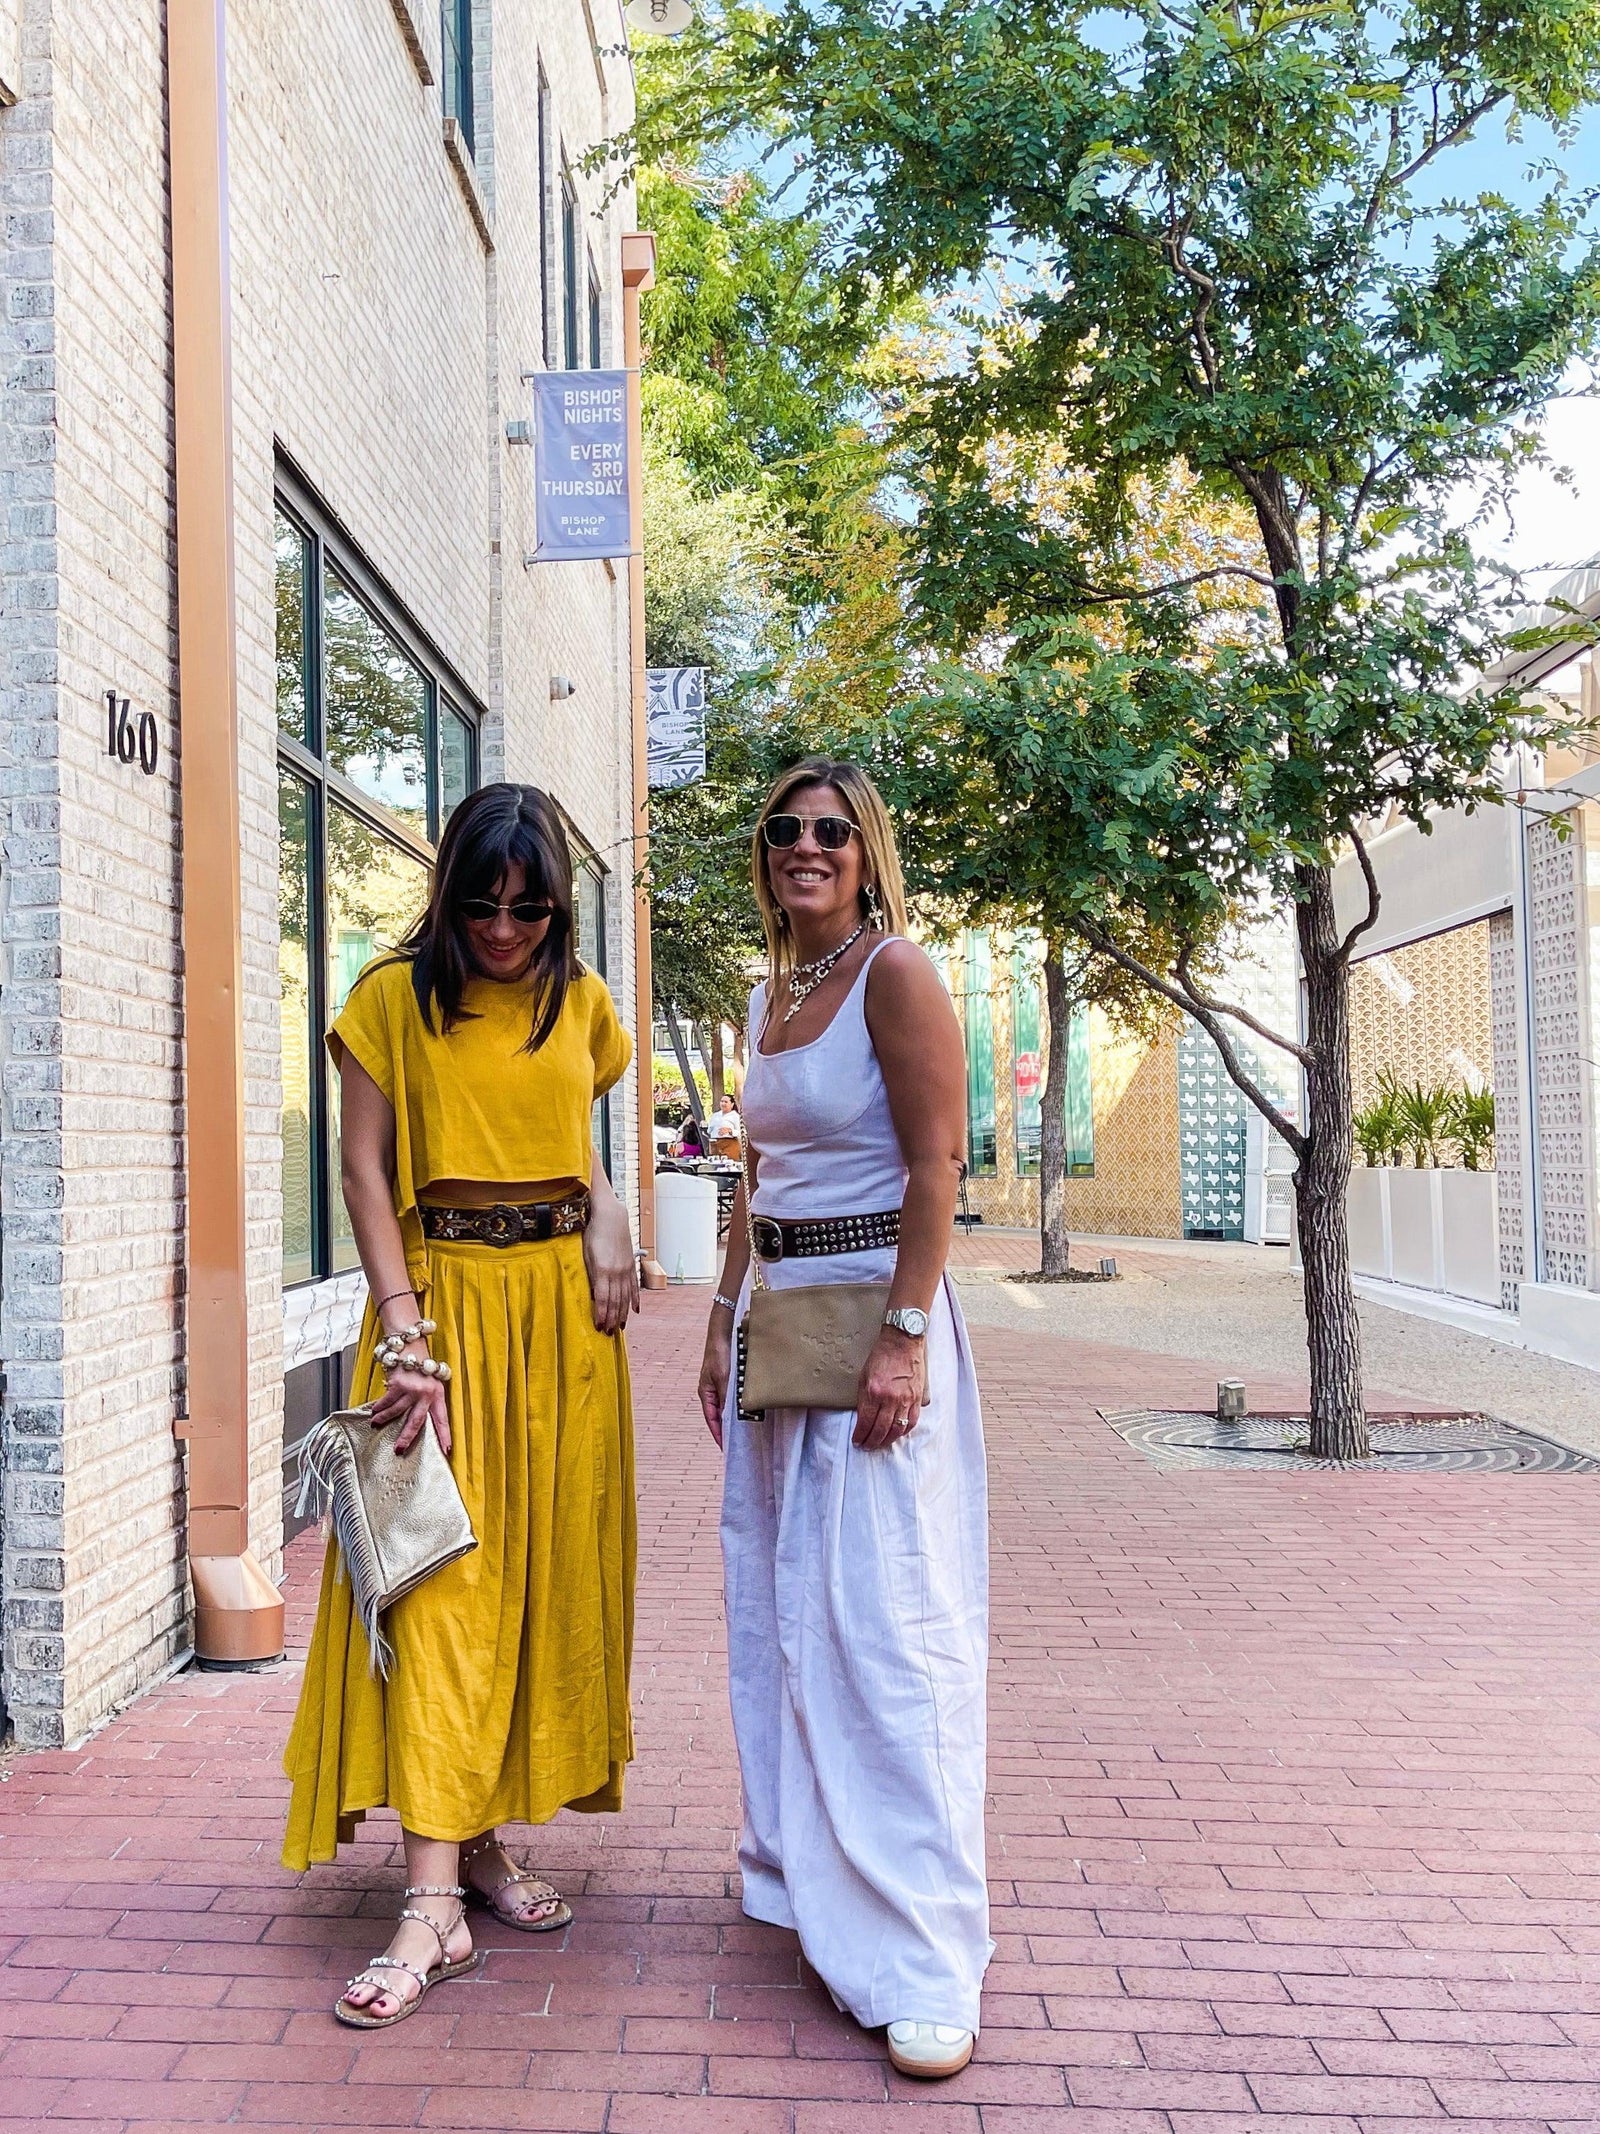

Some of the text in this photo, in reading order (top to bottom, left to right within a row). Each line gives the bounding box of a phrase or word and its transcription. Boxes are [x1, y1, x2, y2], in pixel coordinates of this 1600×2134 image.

[564, 389, 623, 406] BISHOP
[564, 408, 623, 424] NIGHTS
[570, 443, 623, 461] EVERY
[591, 461, 623, 478] 3RD
[541, 479, 624, 496] THURSDAY
[561, 515, 606, 525] BISHOP
[567, 527, 600, 536] LANE
[107, 690, 158, 775] 160
[661, 721, 689, 729] BISHOP
